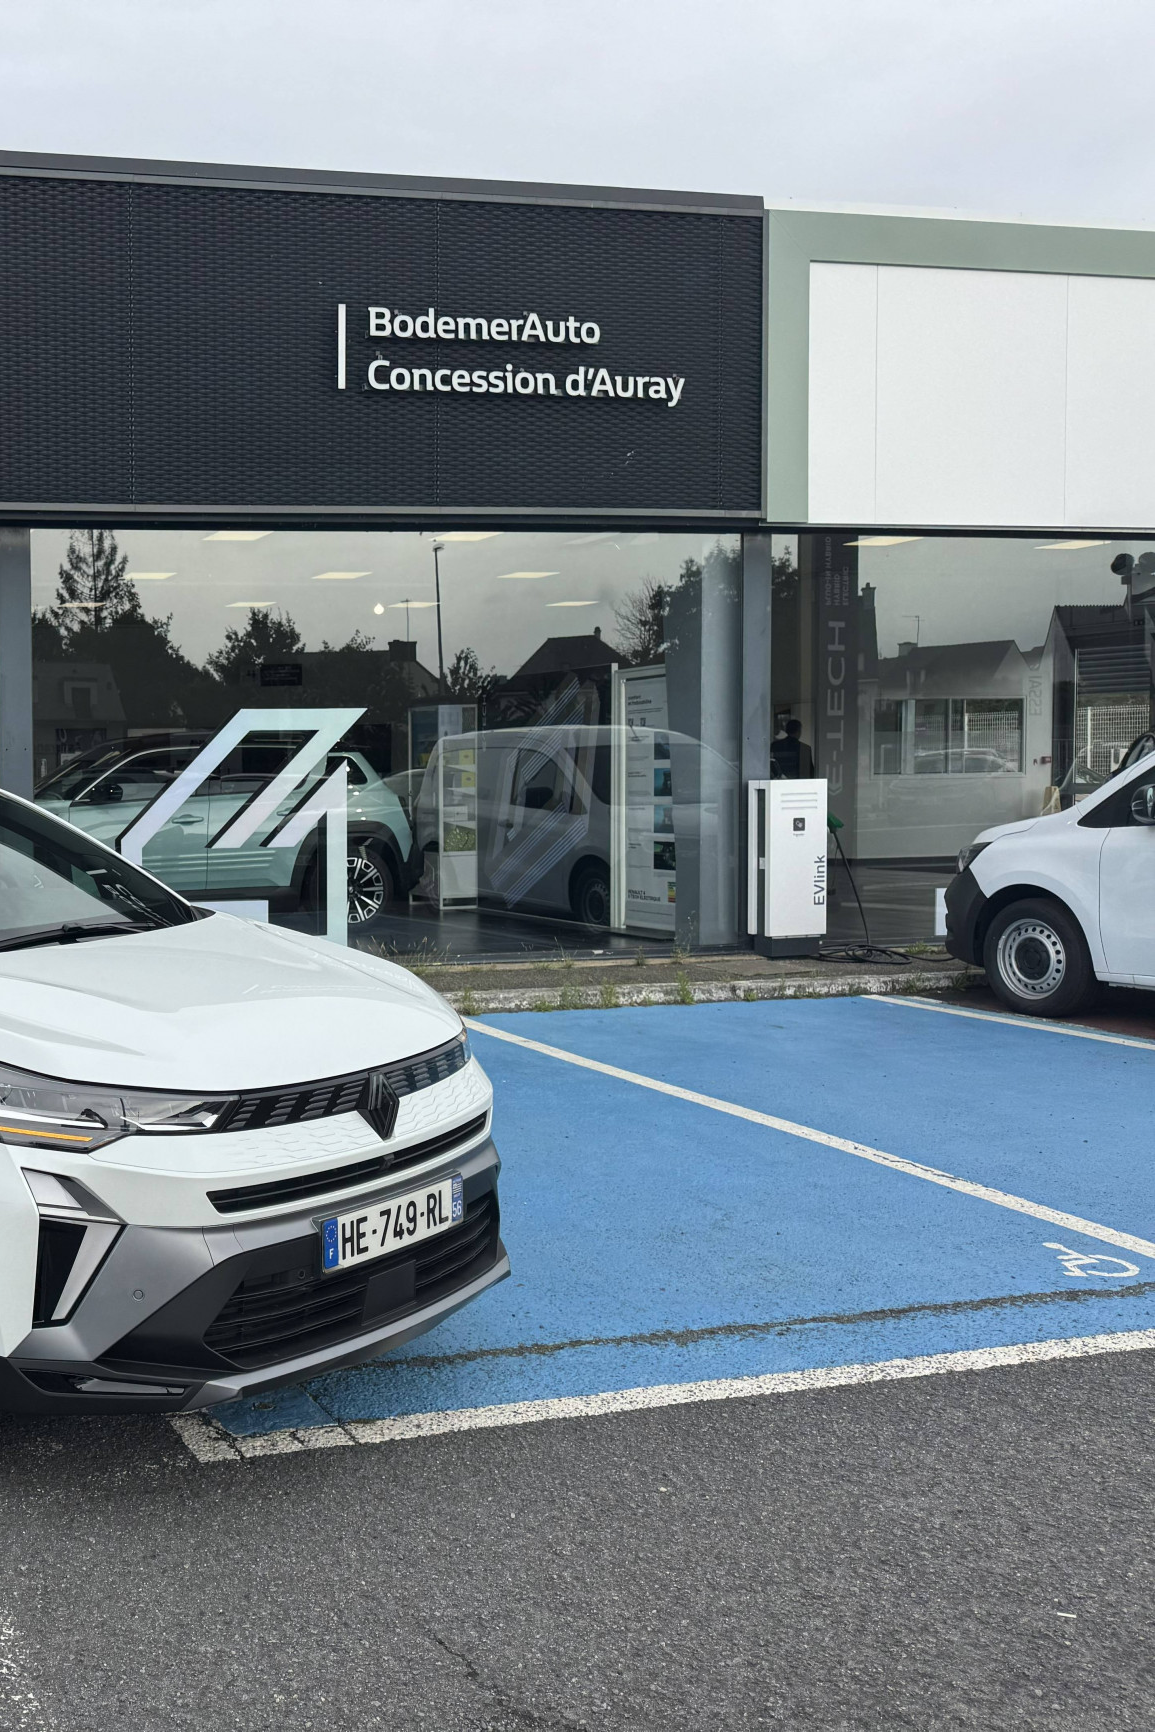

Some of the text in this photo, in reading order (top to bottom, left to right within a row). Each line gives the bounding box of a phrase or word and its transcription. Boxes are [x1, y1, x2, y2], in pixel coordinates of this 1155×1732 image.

[367, 306, 601, 345] BodemerAuto
[367, 360, 686, 407] Concession d'Auray
[813, 855, 826, 905] EVlink
[341, 1190, 449, 1260] HE-749-RL
[452, 1200, 462, 1217] 56
[329, 1248, 335, 1260] F
